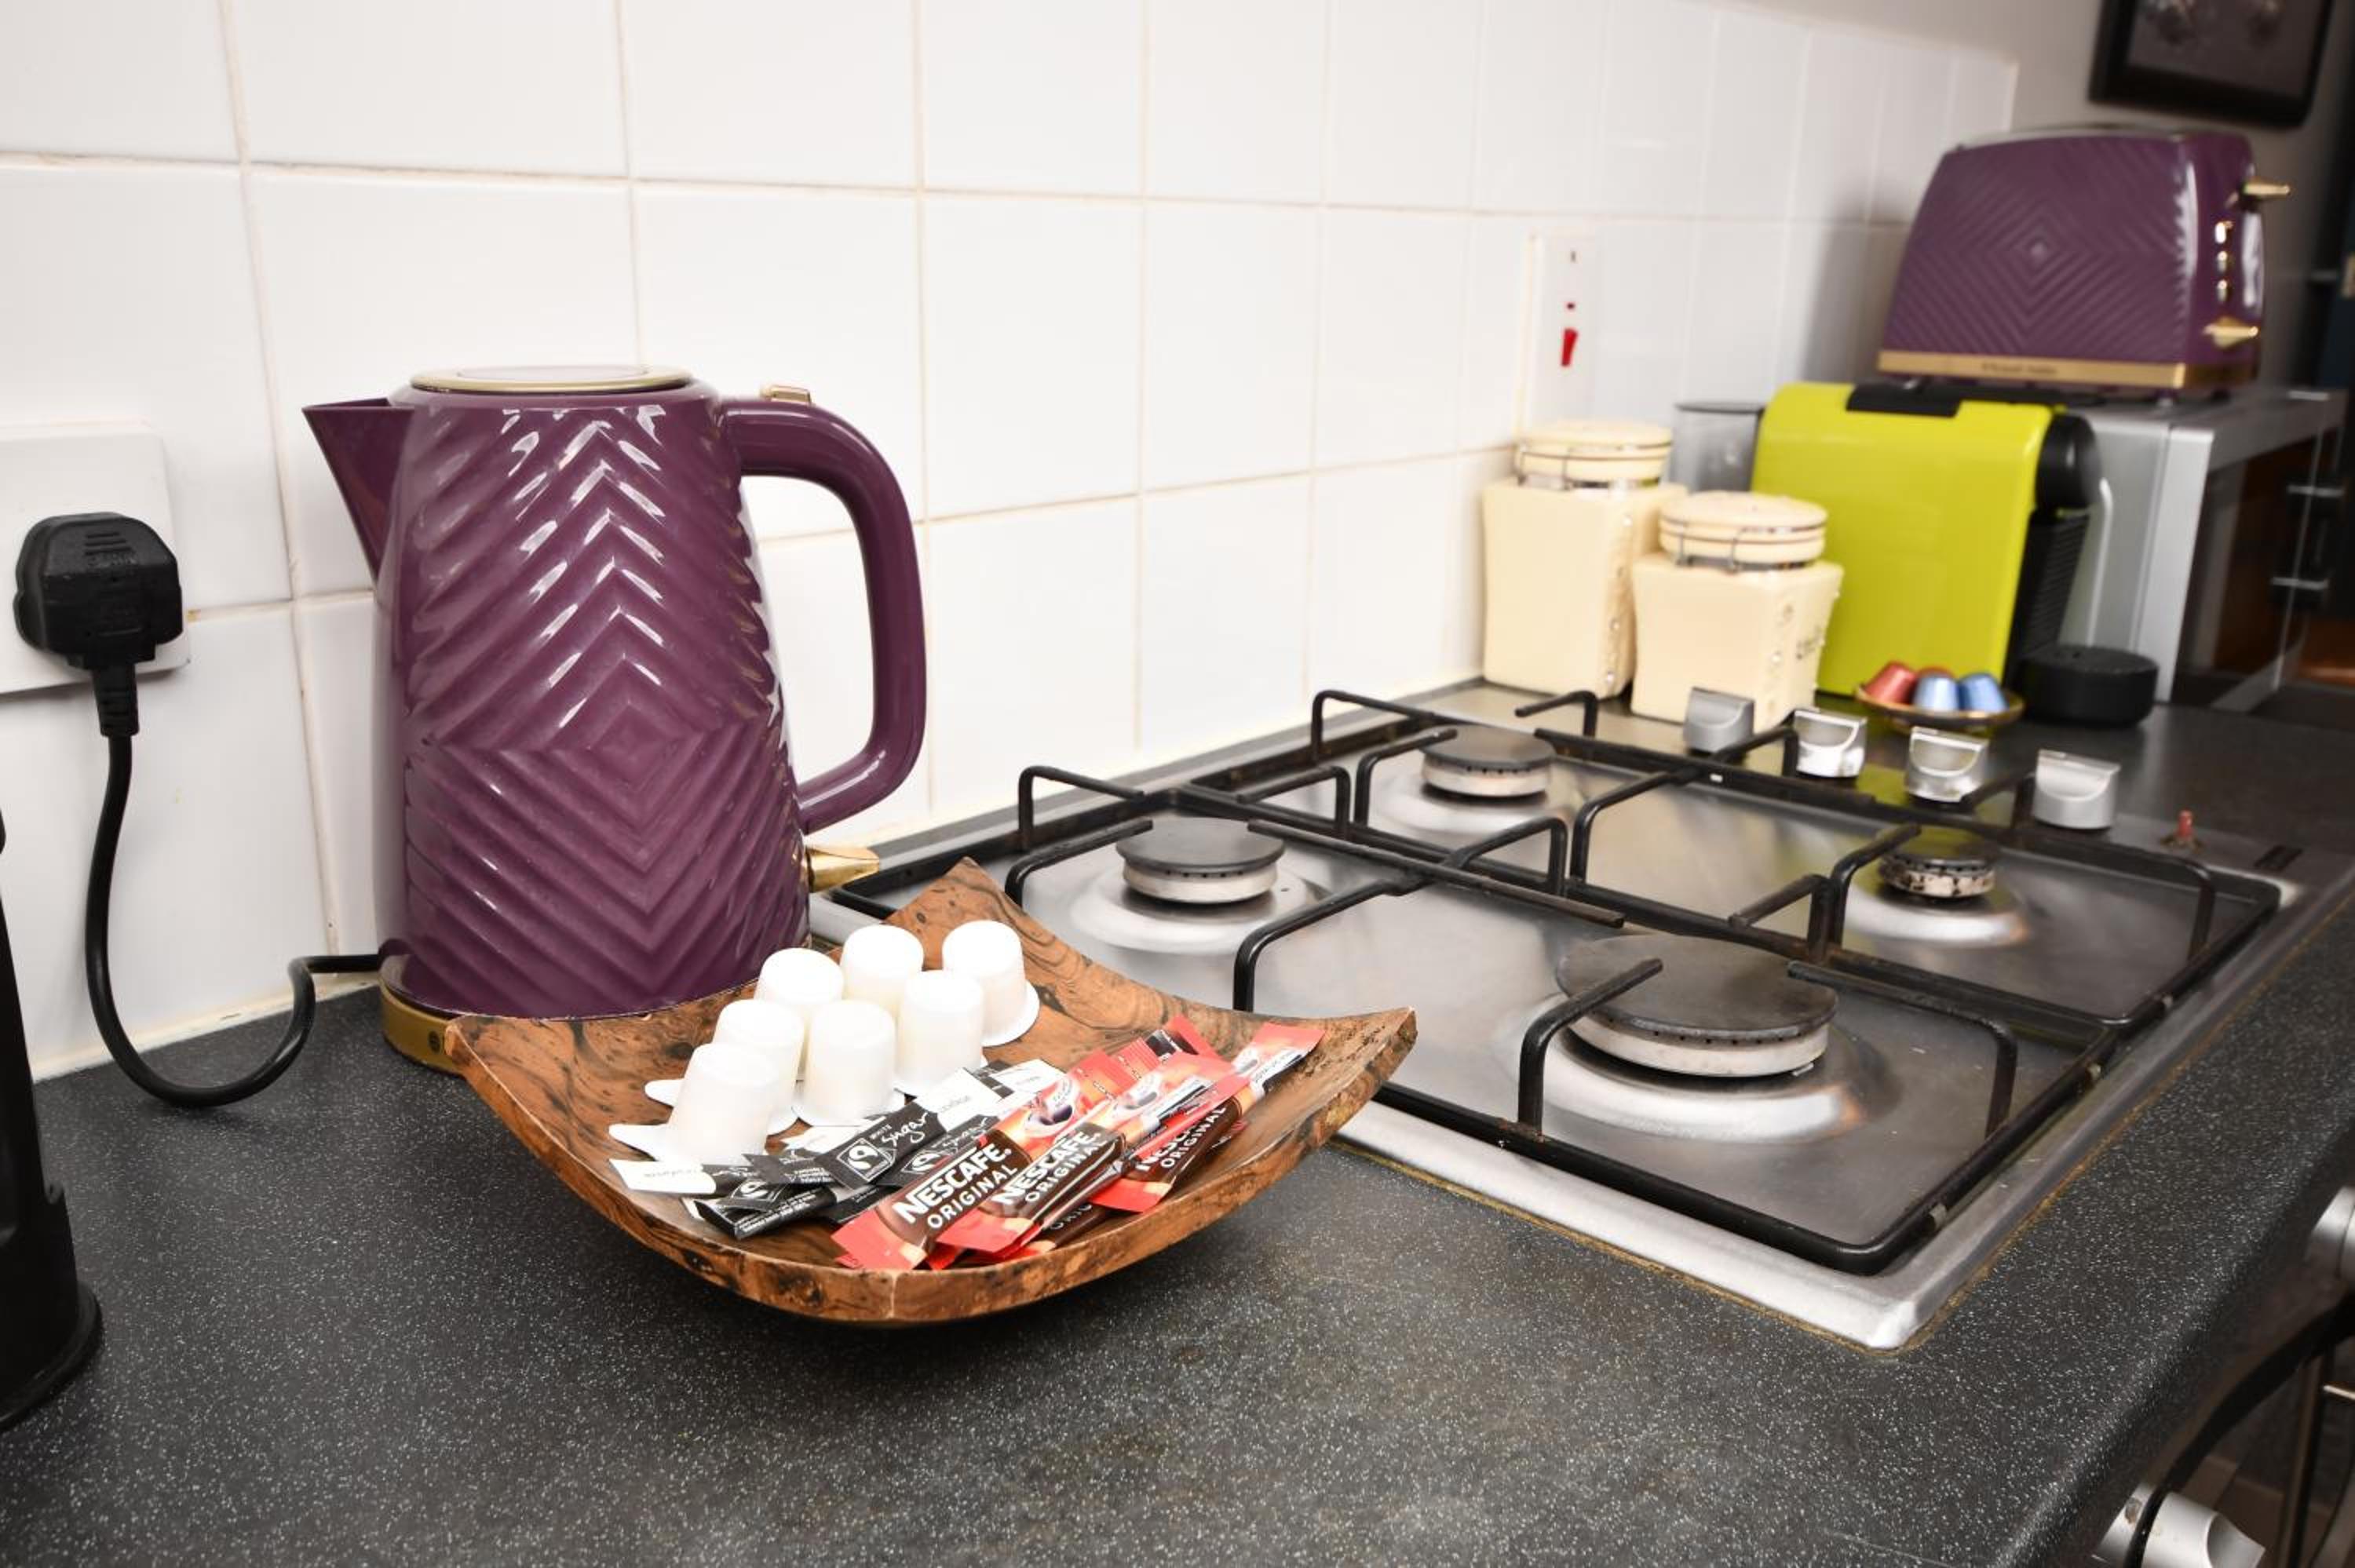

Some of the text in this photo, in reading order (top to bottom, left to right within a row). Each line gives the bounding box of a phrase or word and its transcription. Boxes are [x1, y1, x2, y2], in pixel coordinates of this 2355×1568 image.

[1160, 1107, 1226, 1169] ORIGINAL
[927, 1164, 1018, 1229] ORIGINAL
[1025, 1140, 1108, 1202] ORIGINAL
